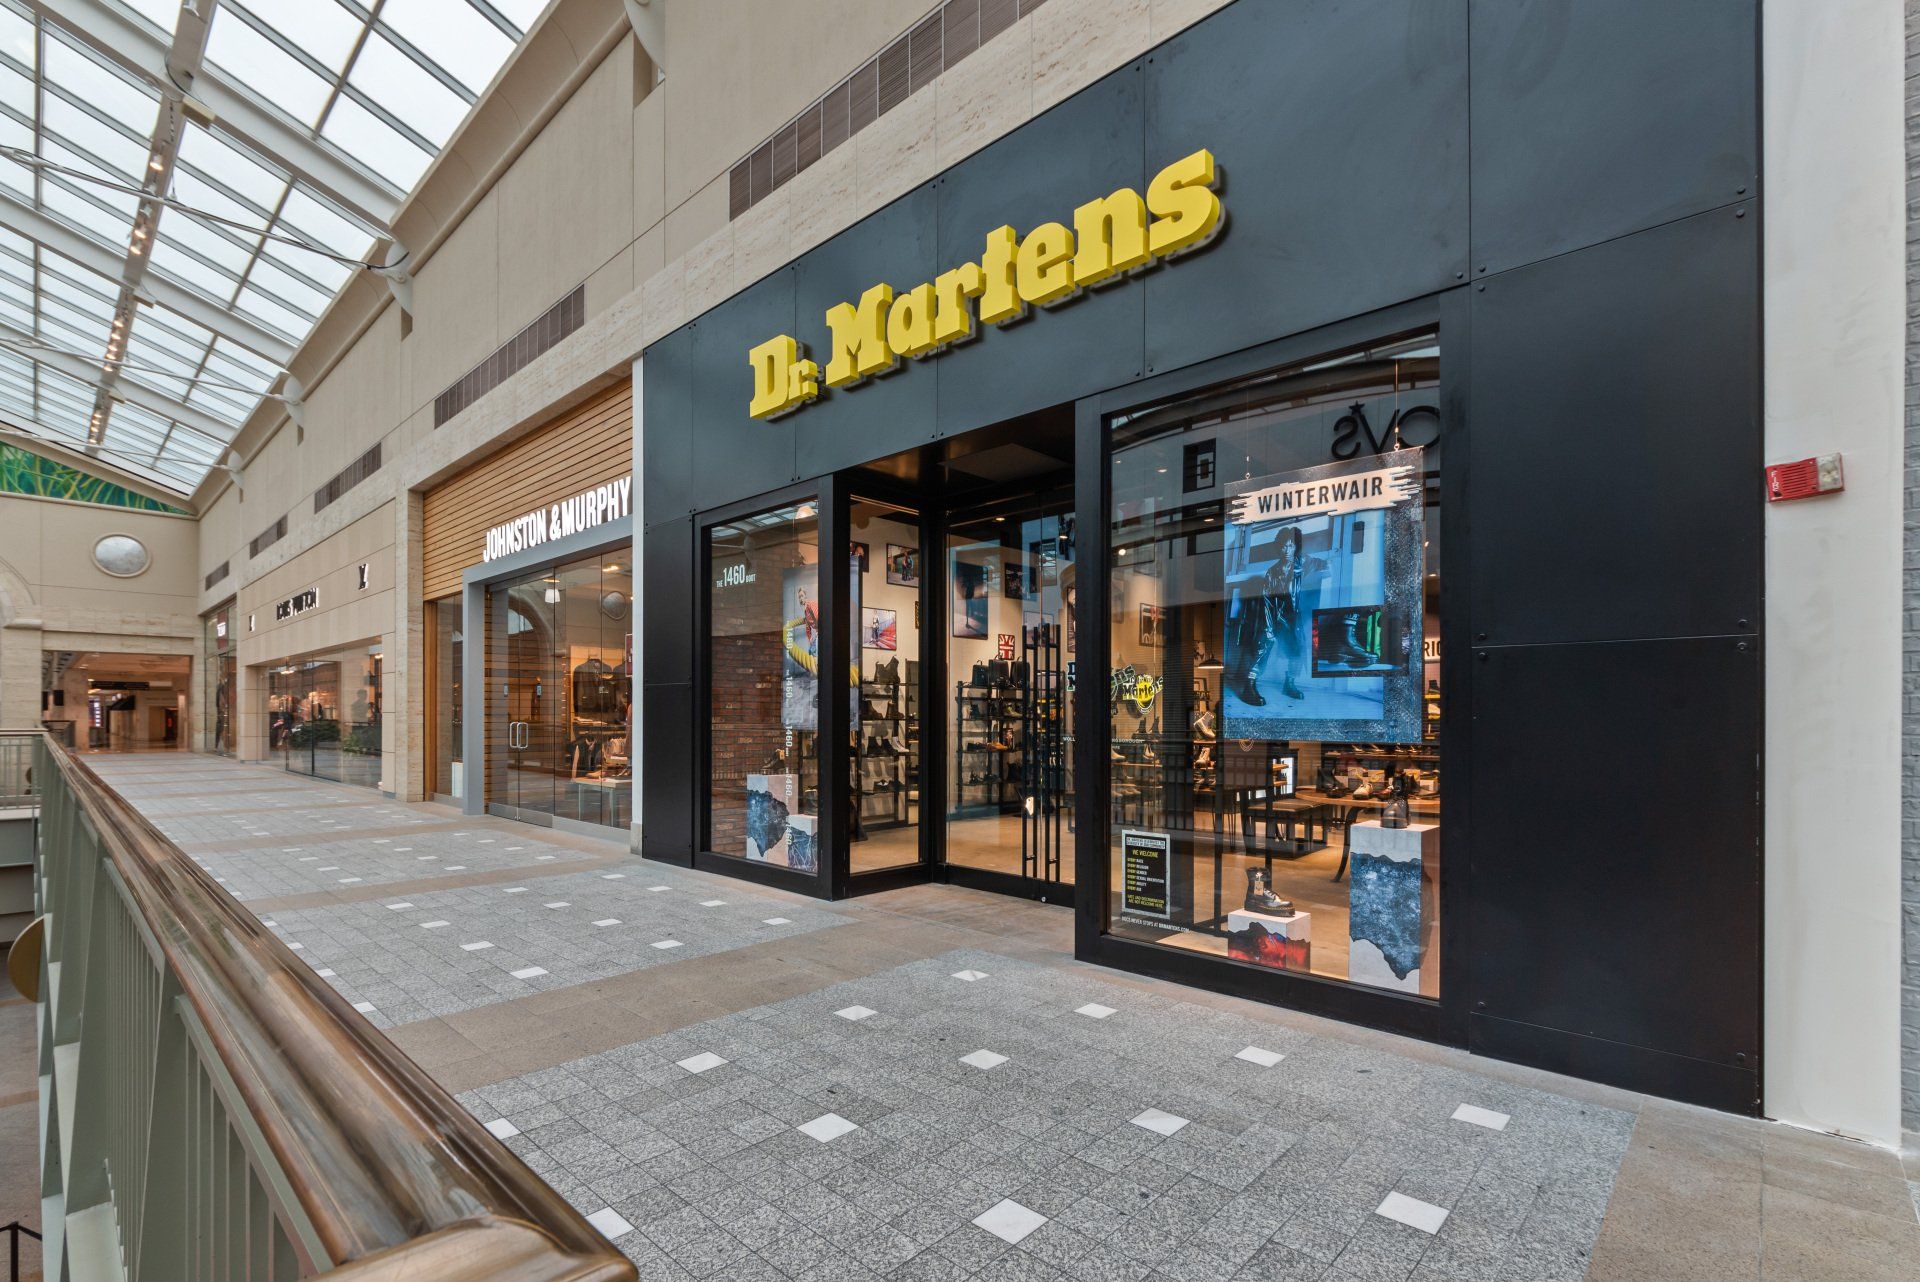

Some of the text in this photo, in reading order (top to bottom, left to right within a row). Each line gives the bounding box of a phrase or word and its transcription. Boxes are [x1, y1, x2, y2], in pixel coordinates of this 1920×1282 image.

[749, 149, 1220, 419] Dr. Martens
[1258, 476, 1383, 514] WINTERWAIR
[483, 508, 547, 563] JOHNSTON
[723, 564, 746, 587] 1460
[785, 725, 793, 747] 1460
